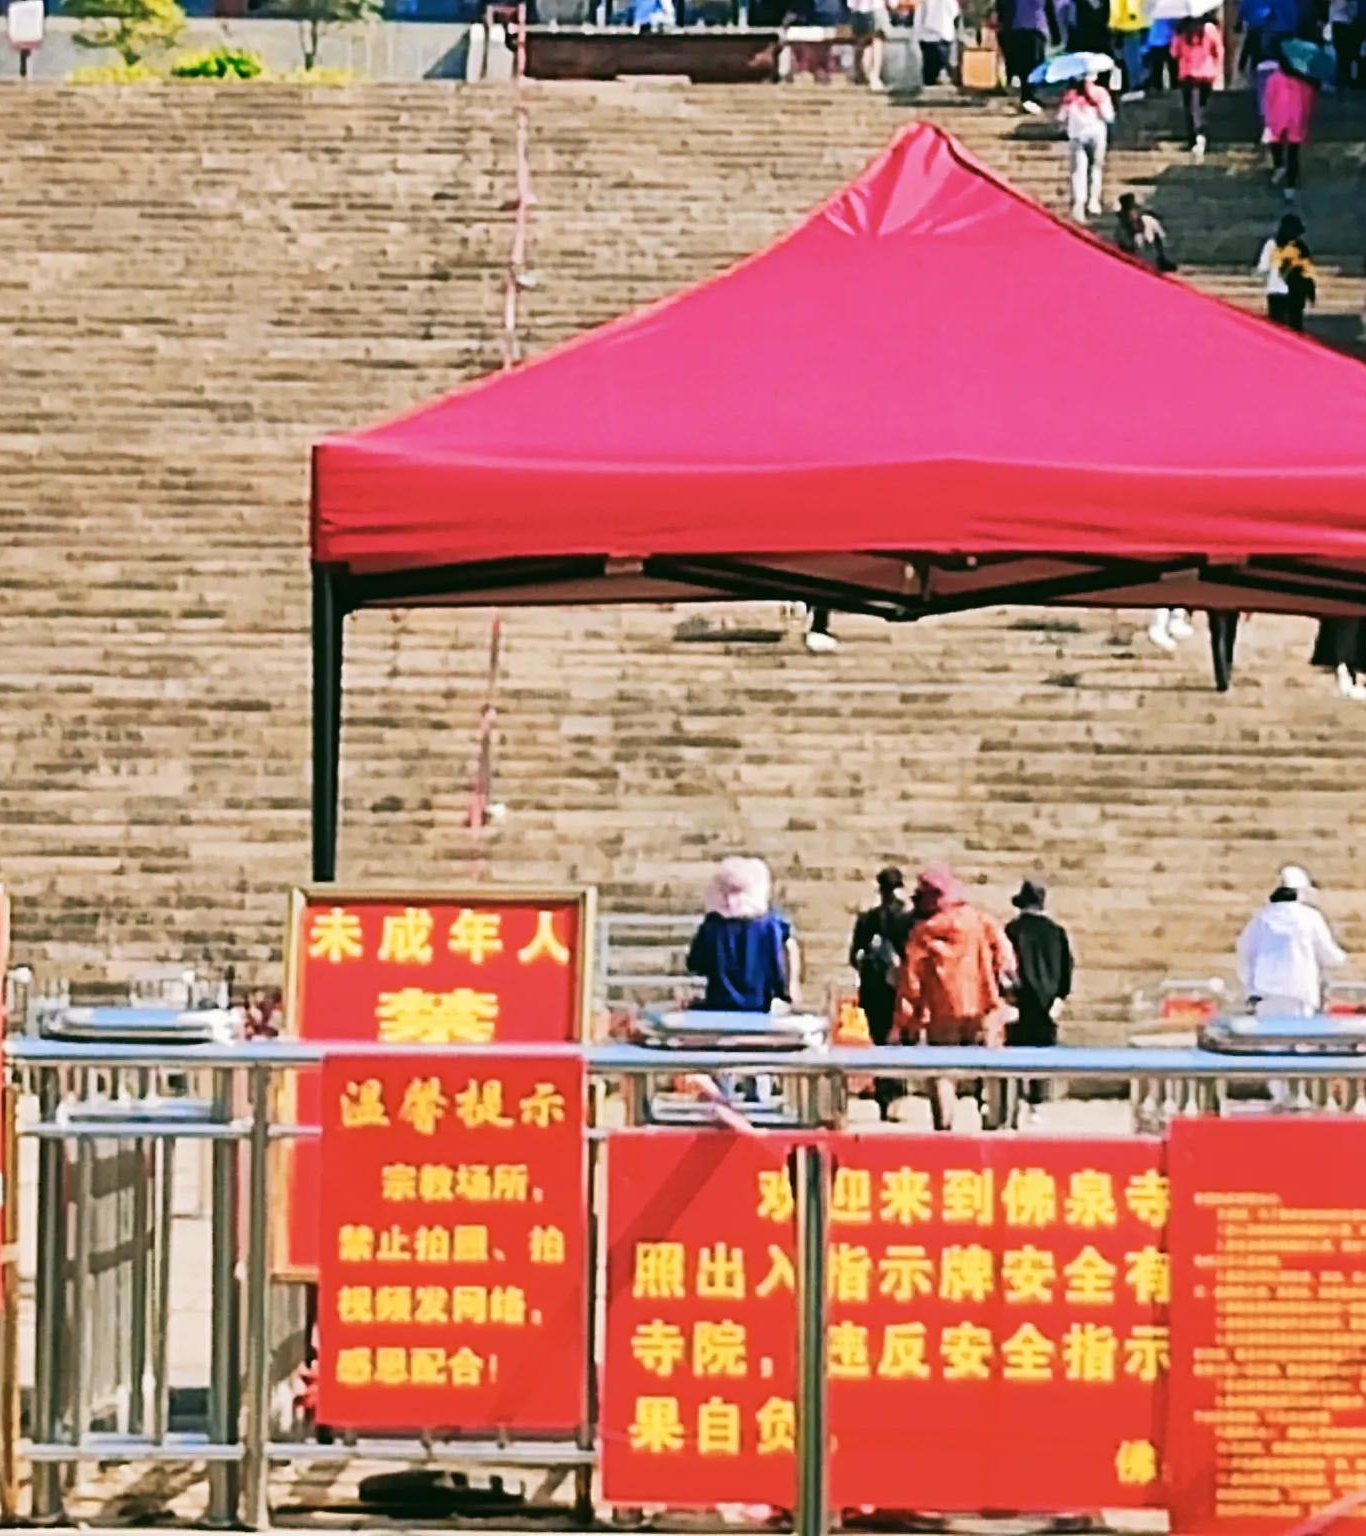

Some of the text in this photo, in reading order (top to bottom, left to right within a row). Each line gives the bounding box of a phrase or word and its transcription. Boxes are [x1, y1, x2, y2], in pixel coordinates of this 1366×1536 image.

[308, 907, 570, 964] 未成年人
[339, 1077, 565, 1135] 温馨提示
